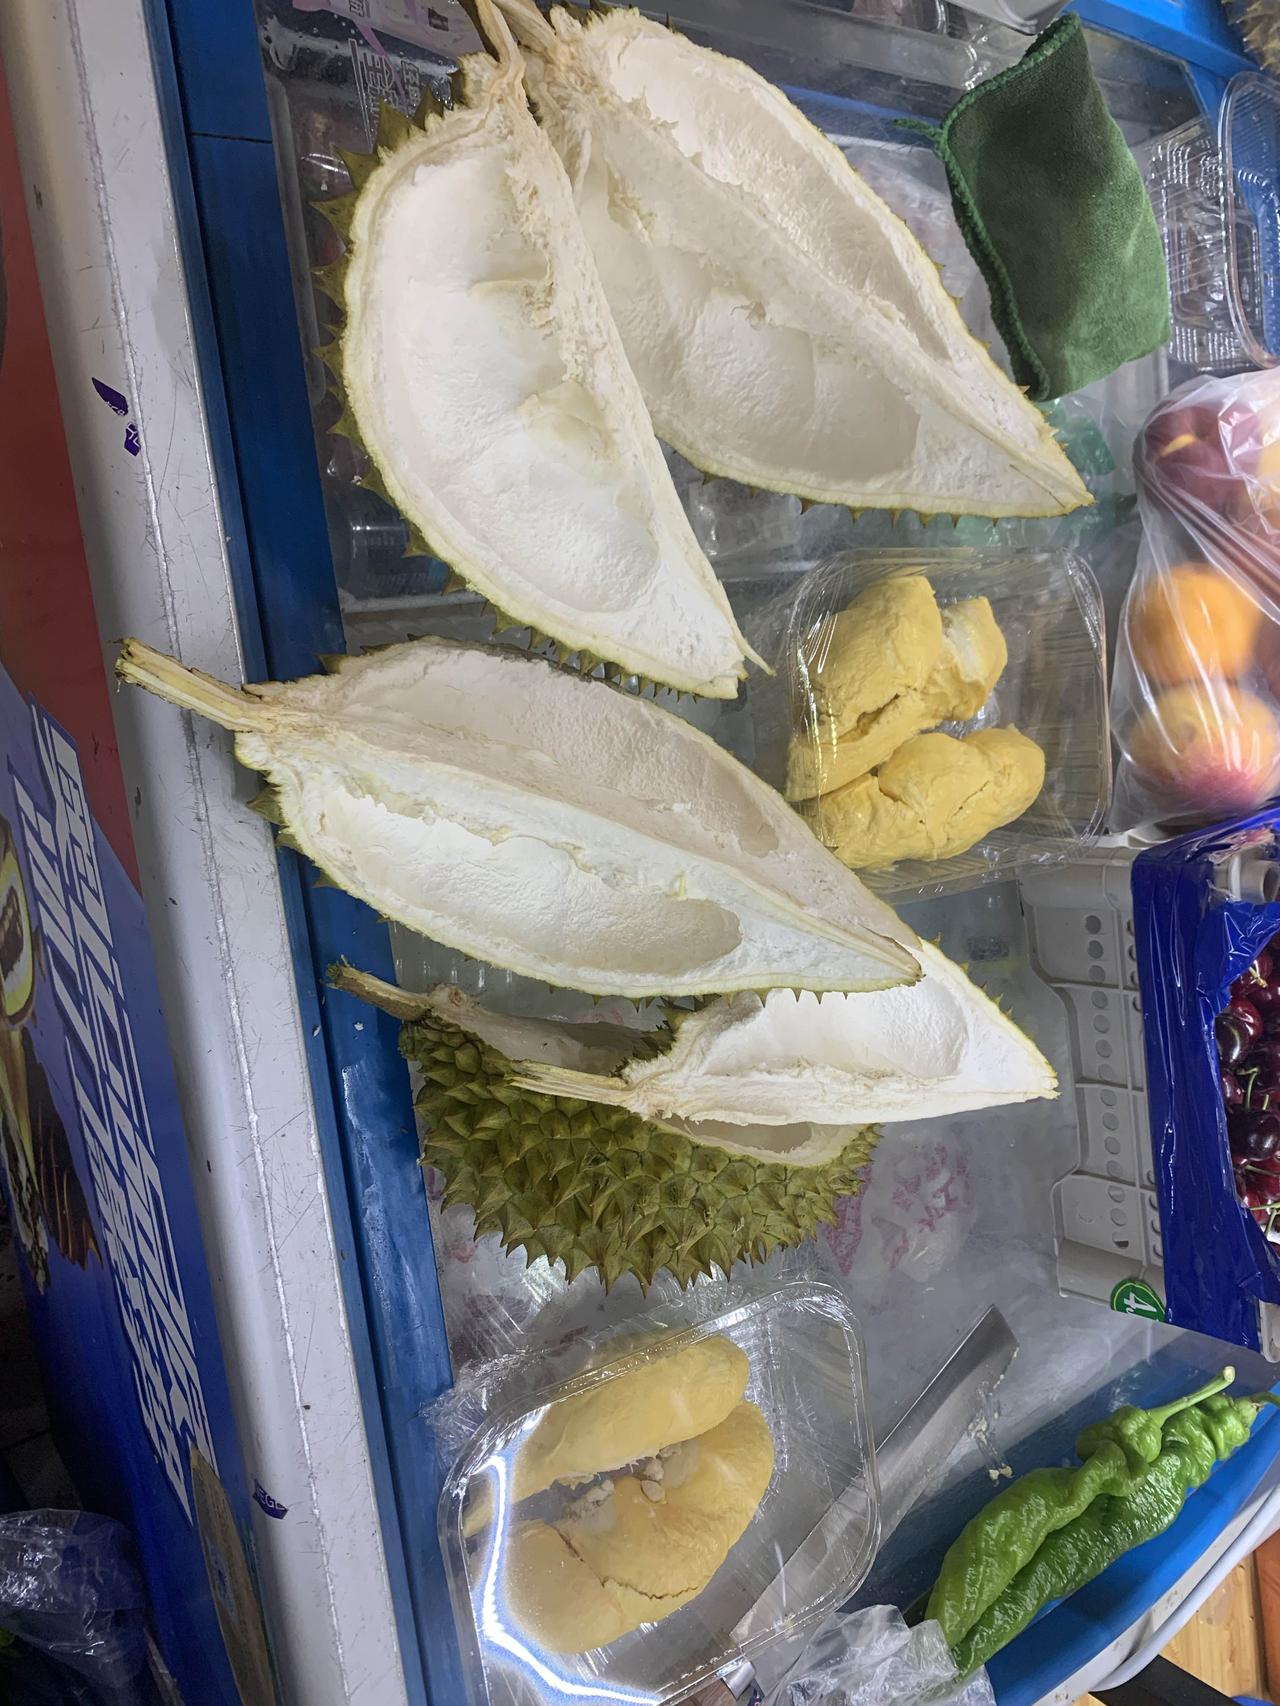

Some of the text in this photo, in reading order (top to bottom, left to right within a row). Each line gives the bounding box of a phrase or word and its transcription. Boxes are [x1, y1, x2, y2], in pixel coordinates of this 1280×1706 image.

[12, 774, 193, 1526] 冰力聚势
[31, 704, 219, 1480] 奥运品质
